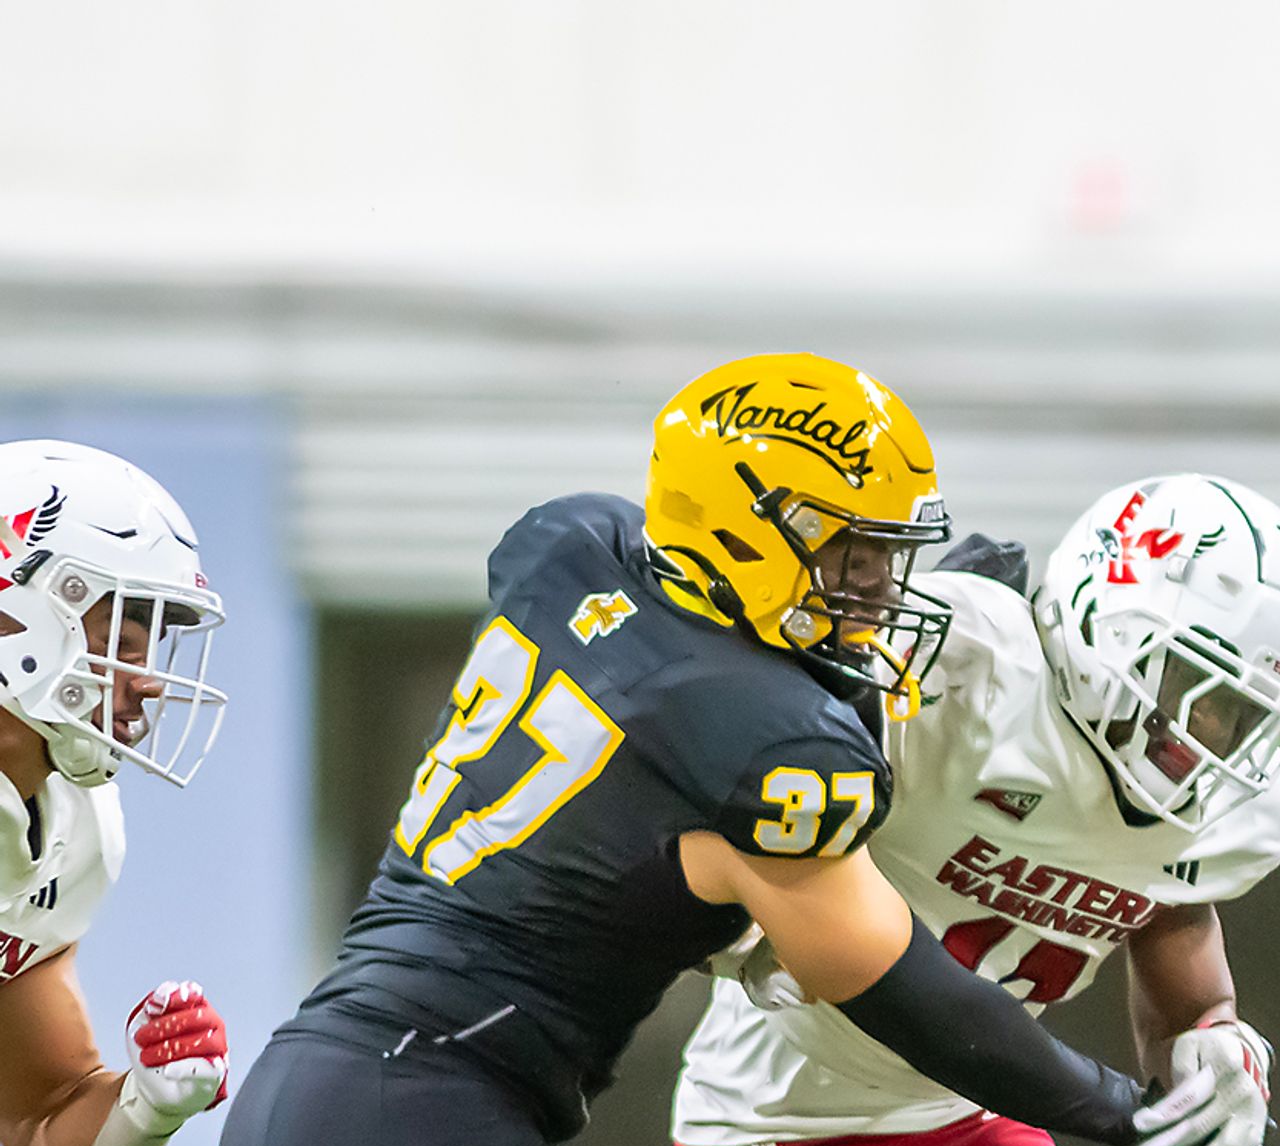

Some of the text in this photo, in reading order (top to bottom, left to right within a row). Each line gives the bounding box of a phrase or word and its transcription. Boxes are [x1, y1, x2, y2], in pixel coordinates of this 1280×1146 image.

[699, 381, 873, 476] Vandals
[394, 614, 627, 887] 37
[753, 766, 875, 857] 37
[951, 834, 1170, 928] EASTER
